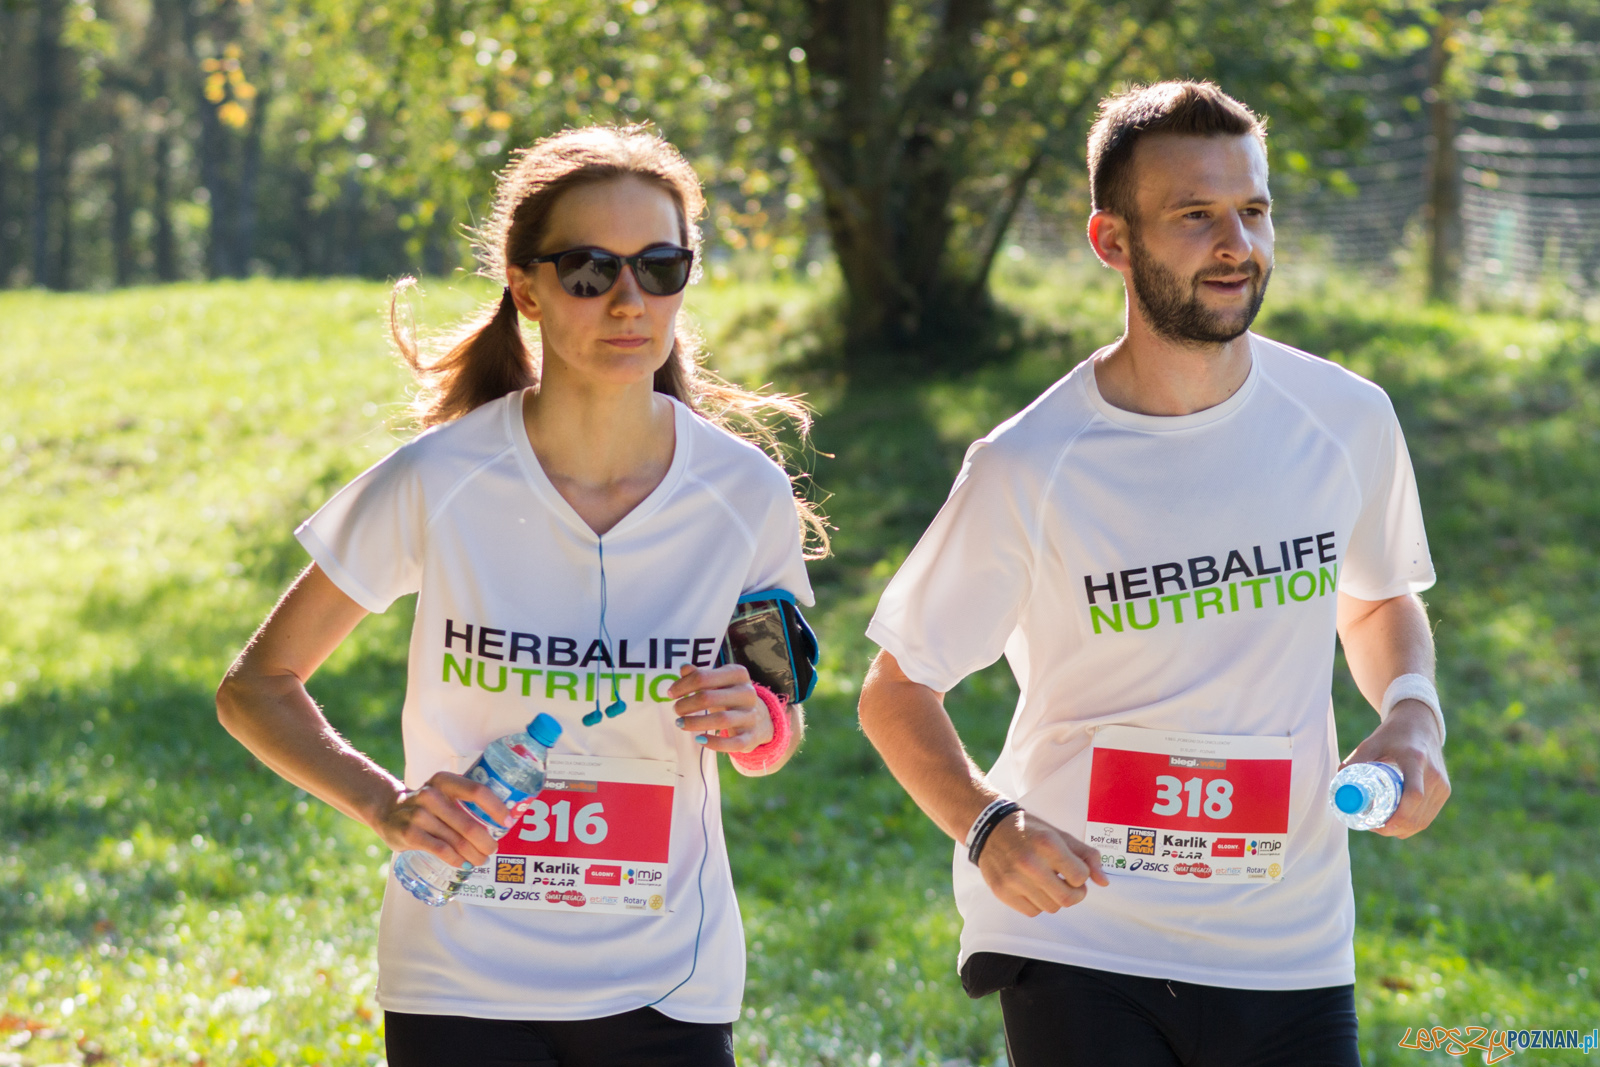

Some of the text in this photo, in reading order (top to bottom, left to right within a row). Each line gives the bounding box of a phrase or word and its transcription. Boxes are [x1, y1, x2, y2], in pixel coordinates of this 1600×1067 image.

[1084, 531, 1337, 604] HERBALIFE
[1090, 563, 1337, 634] NUTRITION
[445, 619, 716, 669] HERBALIFE
[442, 652, 695, 703] NUTRITIO
[1152, 775, 1234, 819] 318
[518, 800, 608, 844] 316
[1130, 829, 1155, 837] FITNESS
[1128, 835, 1154, 847] 24
[1163, 835, 1207, 849] Karlik
[1260, 840, 1282, 852] mjp
[1128, 845, 1154, 854] SEVEN
[1162, 850, 1203, 859] POLAR
[497, 856, 526, 865] FITNESS
[497, 863, 525, 876] 24
[534, 861, 580, 876] Karlik
[1246, 866, 1268, 875] Rotary
[496, 874, 524, 883] SEVEN
[637, 869, 662, 882] mjp
[532, 877, 576, 887] POLAR
[623, 896, 648, 906] Rotary
